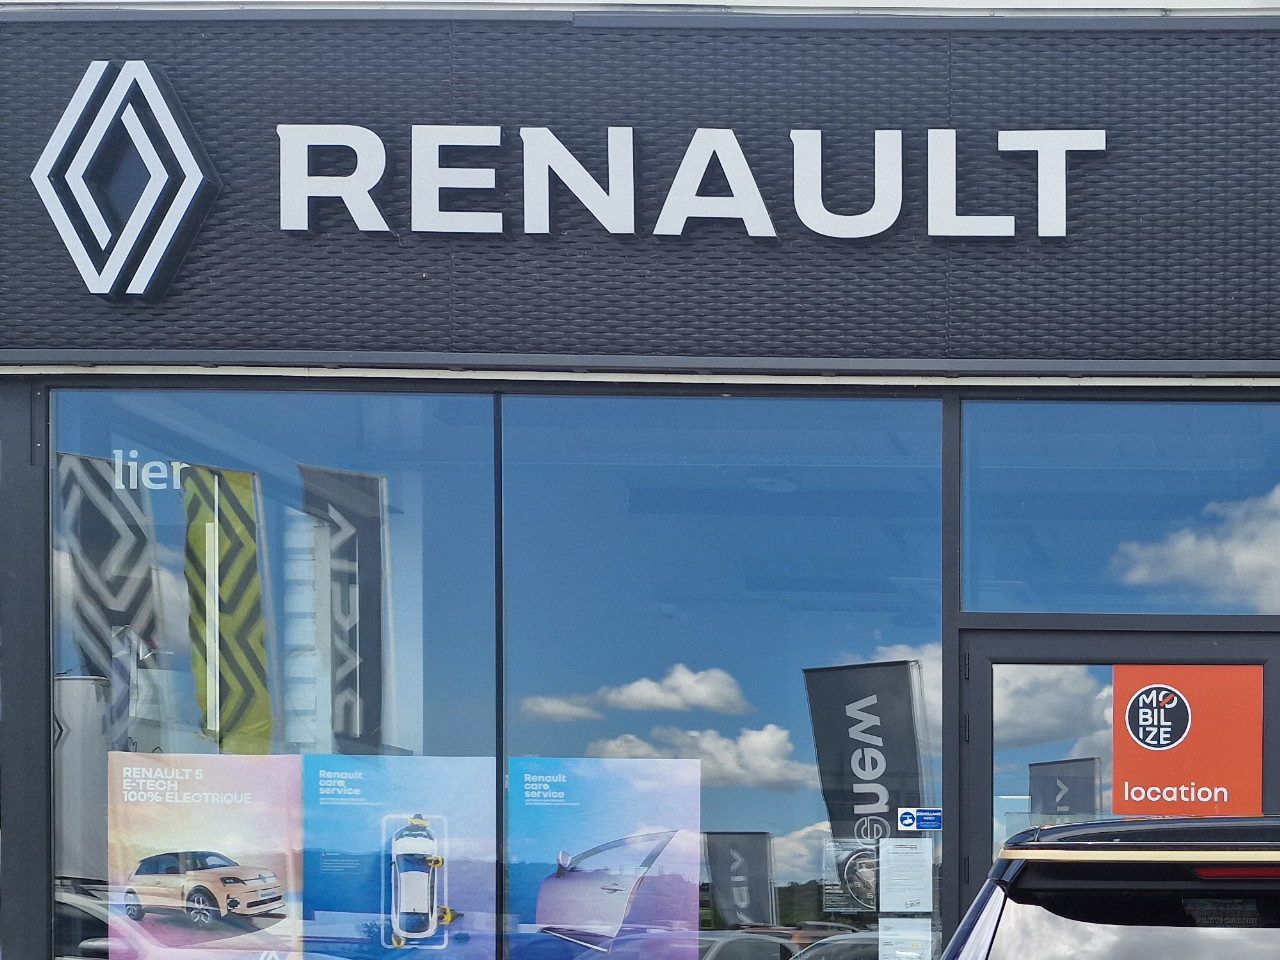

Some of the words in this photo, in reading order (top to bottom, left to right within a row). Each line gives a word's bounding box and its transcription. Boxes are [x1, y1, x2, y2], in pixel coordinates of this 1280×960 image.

[277, 123, 1107, 239] RENAULT
[1138, 708, 1172, 726] BIL
[1138, 726, 1172, 745] IZE
[122, 767, 193, 780] RENAULT
[194, 768, 204, 780] 5
[319, 769, 364, 780] Renault
[523, 773, 567, 783] Renault
[122, 779, 178, 791] E-TECH
[319, 779, 345, 787] care
[523, 782, 550, 790] care
[319, 785, 361, 795] service
[524, 788, 565, 799] service
[1124, 781, 1229, 802] location
[122, 790, 162, 803] 100%
